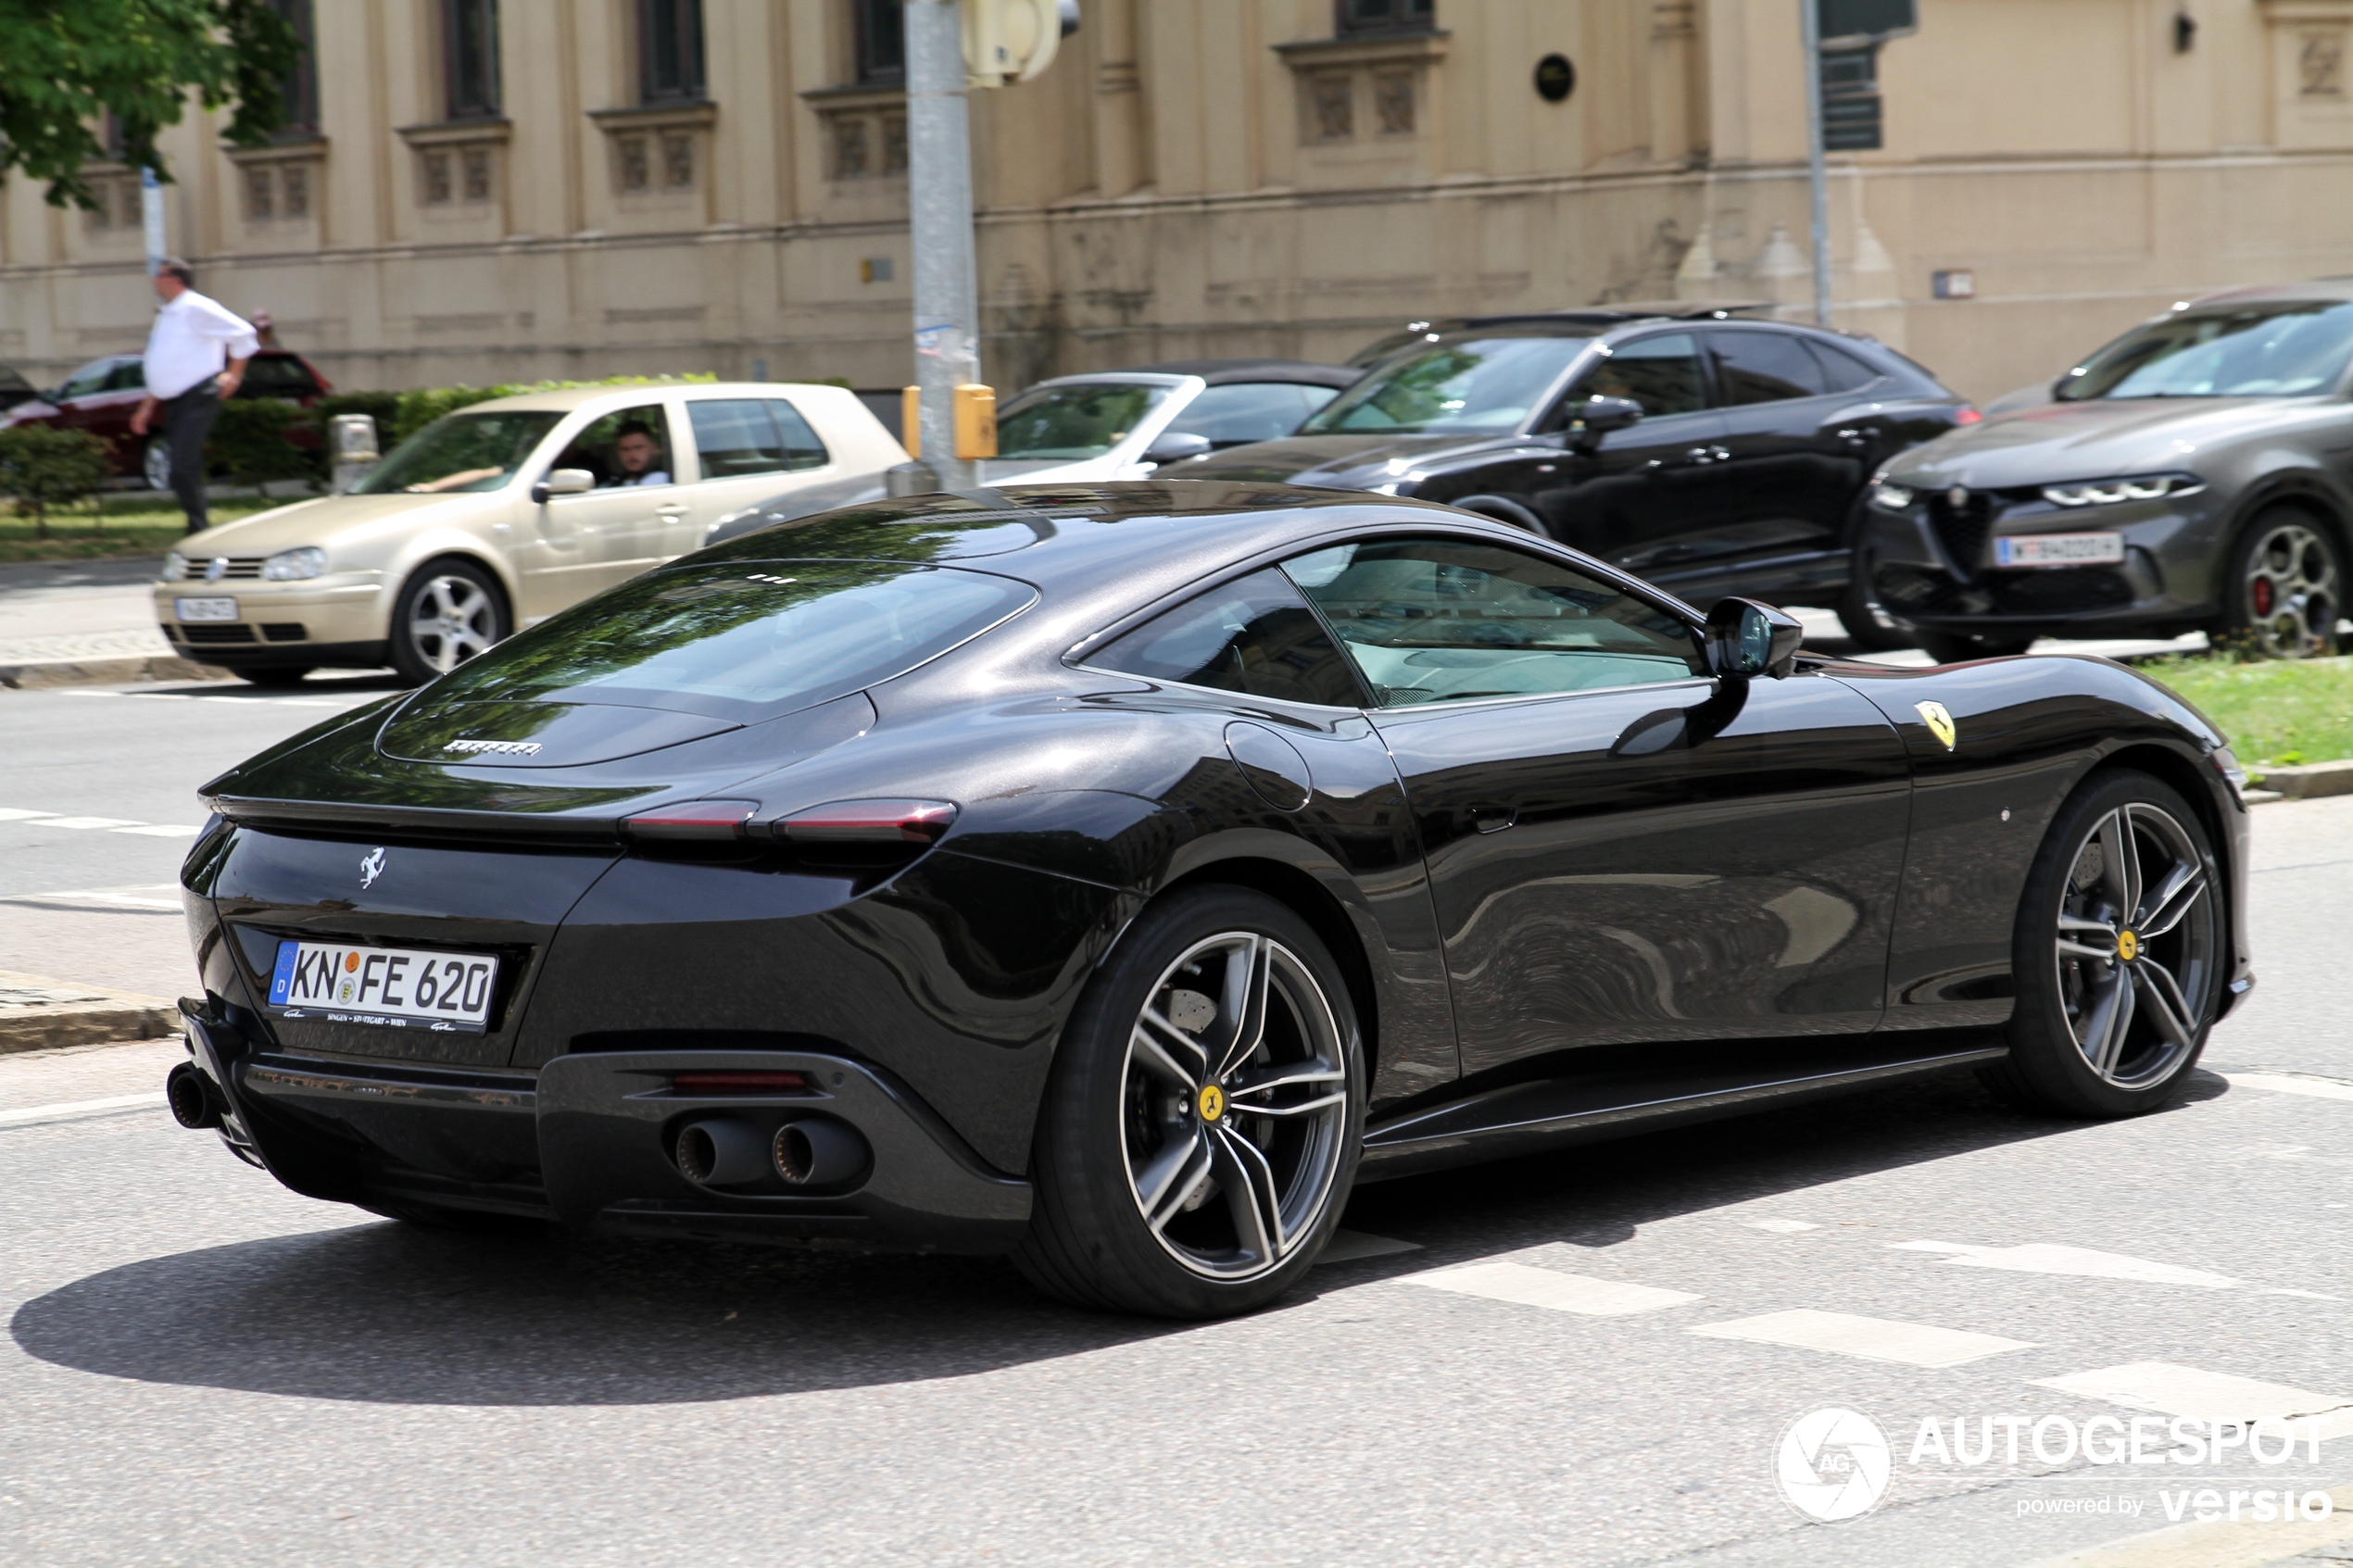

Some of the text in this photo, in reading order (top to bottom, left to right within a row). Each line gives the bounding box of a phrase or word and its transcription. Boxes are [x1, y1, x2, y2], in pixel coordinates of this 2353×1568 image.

[277, 979, 285, 994] D
[291, 949, 489, 1012] KN FE 620
